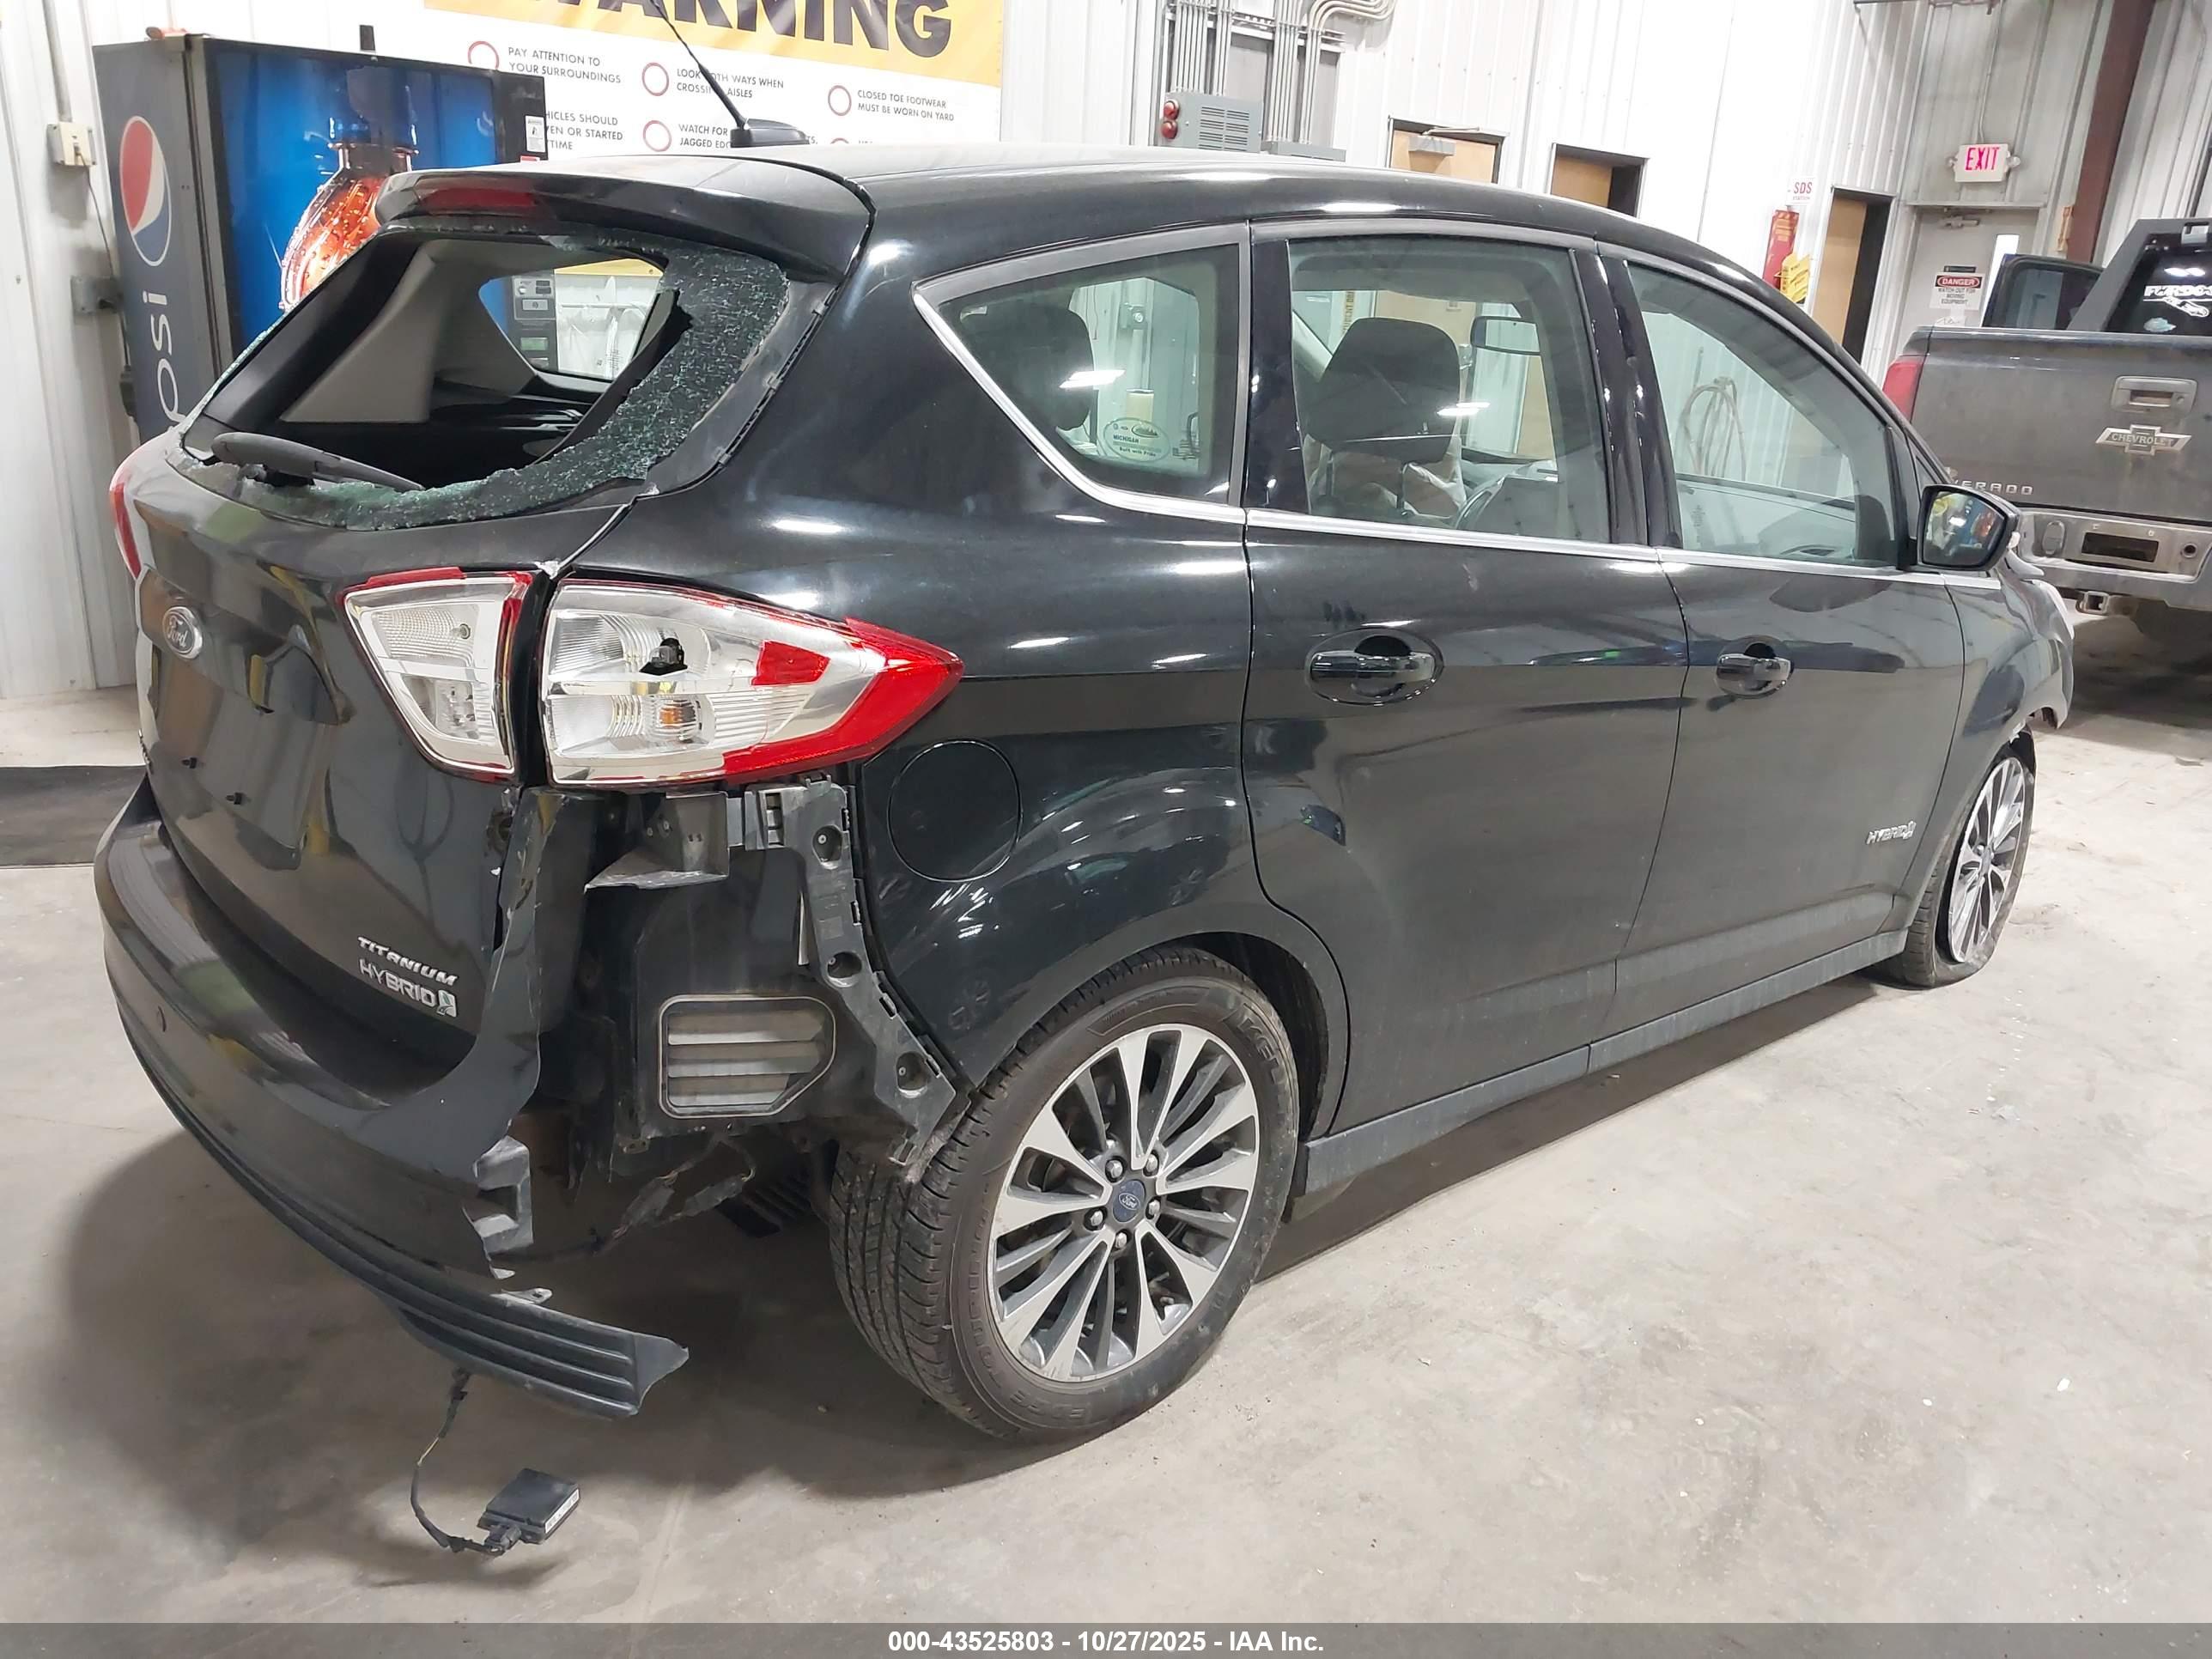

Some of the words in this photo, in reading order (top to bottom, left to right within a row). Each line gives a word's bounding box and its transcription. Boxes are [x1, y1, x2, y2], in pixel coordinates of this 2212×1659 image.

[508, 46, 527, 58] PAY
[532, 50, 585, 64] ATTENTION
[588, 57, 600, 67] TO
[508, 62, 538, 74] YOUR
[542, 66, 621, 83] SURROUNDINGS
[677, 68, 701, 79] LOOK
[732, 74, 757, 86] WAYS
[758, 77, 784, 88] WHEN
[727, 88, 753, 99] AISLES
[857, 89, 887, 100] CLOSED
[890, 93, 904, 102] TOE
[906, 94, 946, 108] FOOTWEAR
[579, 113, 618, 125] SHOULD
[858, 102, 879, 112] MUST
[882, 106, 891, 114] BE
[894, 107, 919, 117] WORN
[921, 110, 933, 118] ON
[935, 112, 955, 122] YARD
[568, 127, 582, 137] OR
[586, 129, 623, 141] STARTED
[678, 123, 709, 134] WATCH
[712, 126, 728, 137] FOR
[679, 137, 713, 148] JAGGED
[1965, 147, 2000, 171] EXIT
[1793, 181, 1813, 194] SDS
[1942, 277, 1975, 287] DANGER
[1113, 434, 1139, 444] MICHIGAN
[2111, 432, 2175, 447] CHEVROLET
[1866, 825, 1908, 845] HYBRID
[357, 936, 459, 987] TITANIUM
[359, 958, 437, 1008] HYBRID
